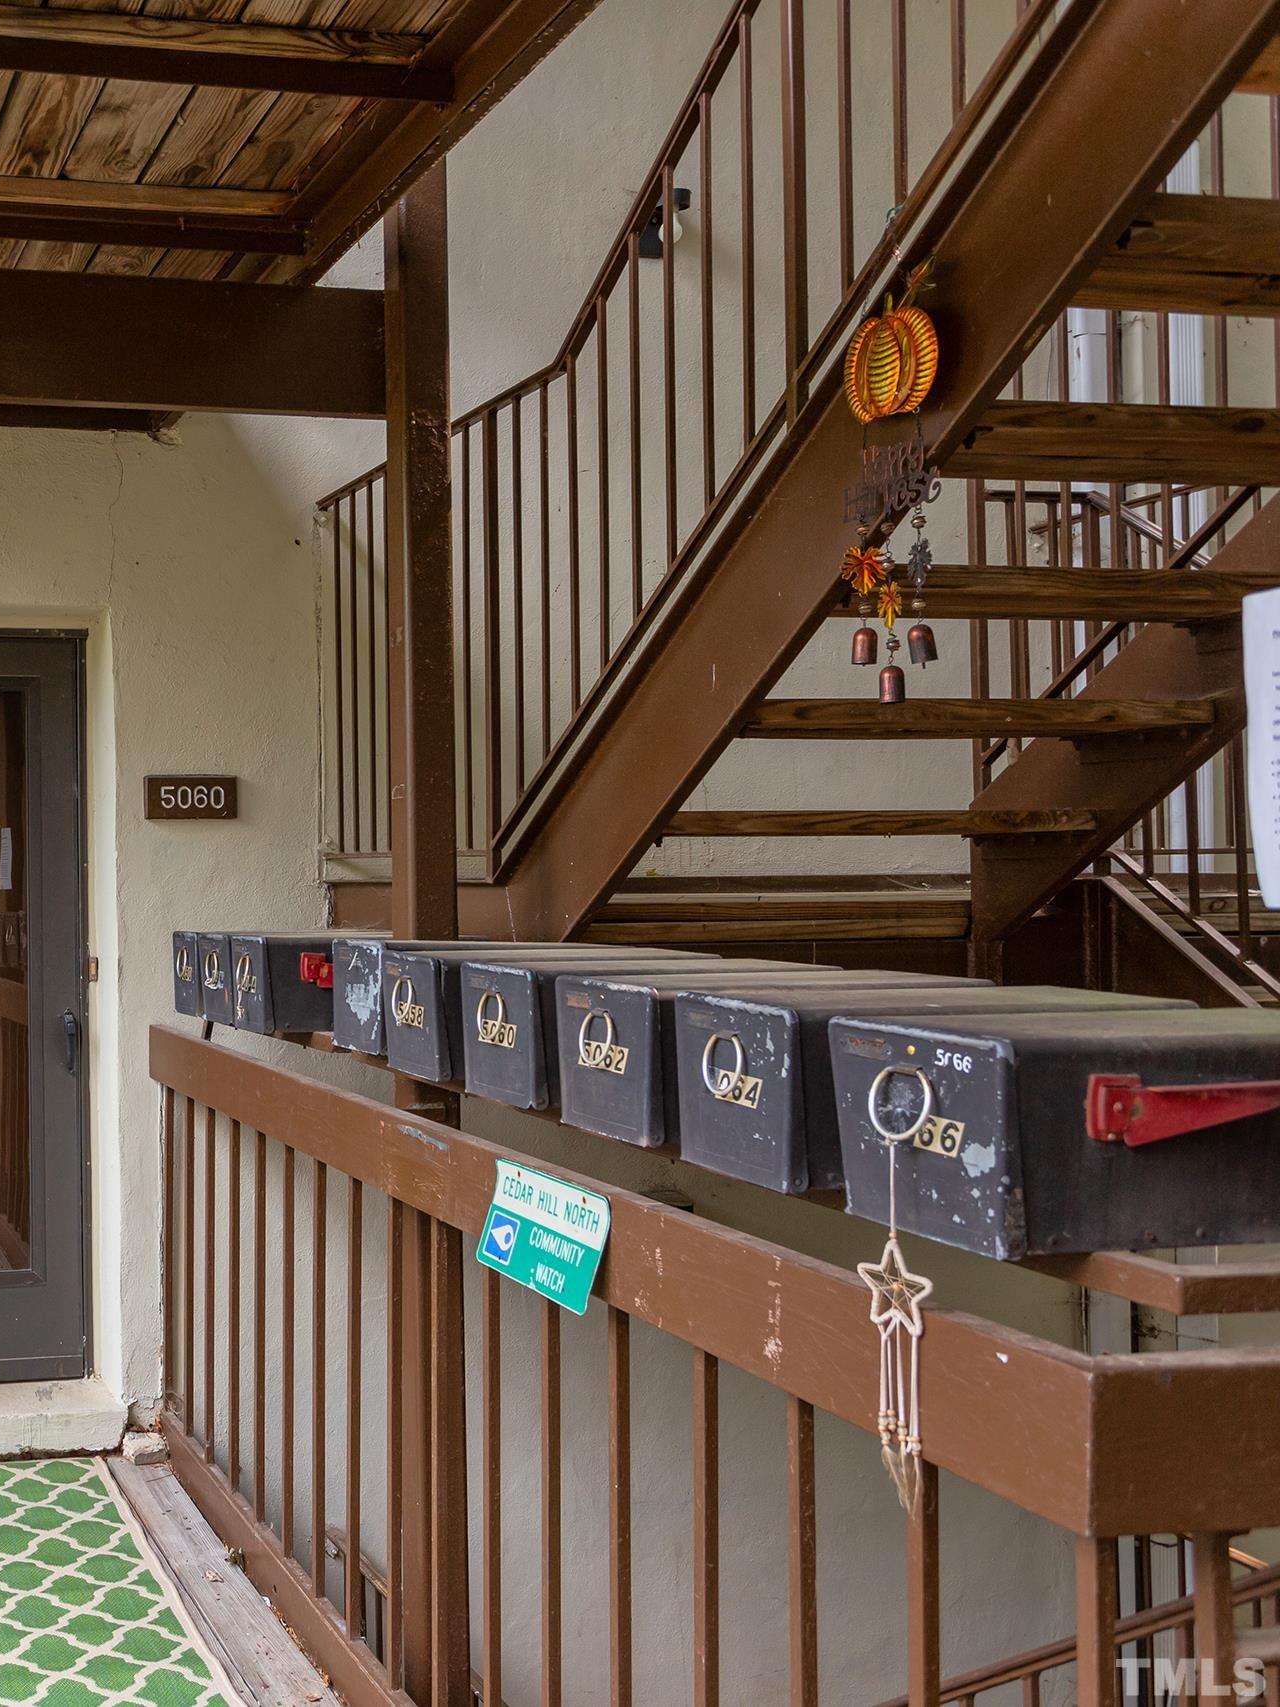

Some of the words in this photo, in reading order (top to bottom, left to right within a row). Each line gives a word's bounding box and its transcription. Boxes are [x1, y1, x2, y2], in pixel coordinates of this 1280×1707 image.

[160, 785, 225, 809] 5060
[920, 1116, 960, 1154] 66
[502, 1175, 534, 1206] CEDAR
[537, 1189, 559, 1218] HILL
[563, 1200, 601, 1234] NORTH
[528, 1226, 585, 1268] COMMUNITY
[535, 1262, 566, 1294] WATCH
